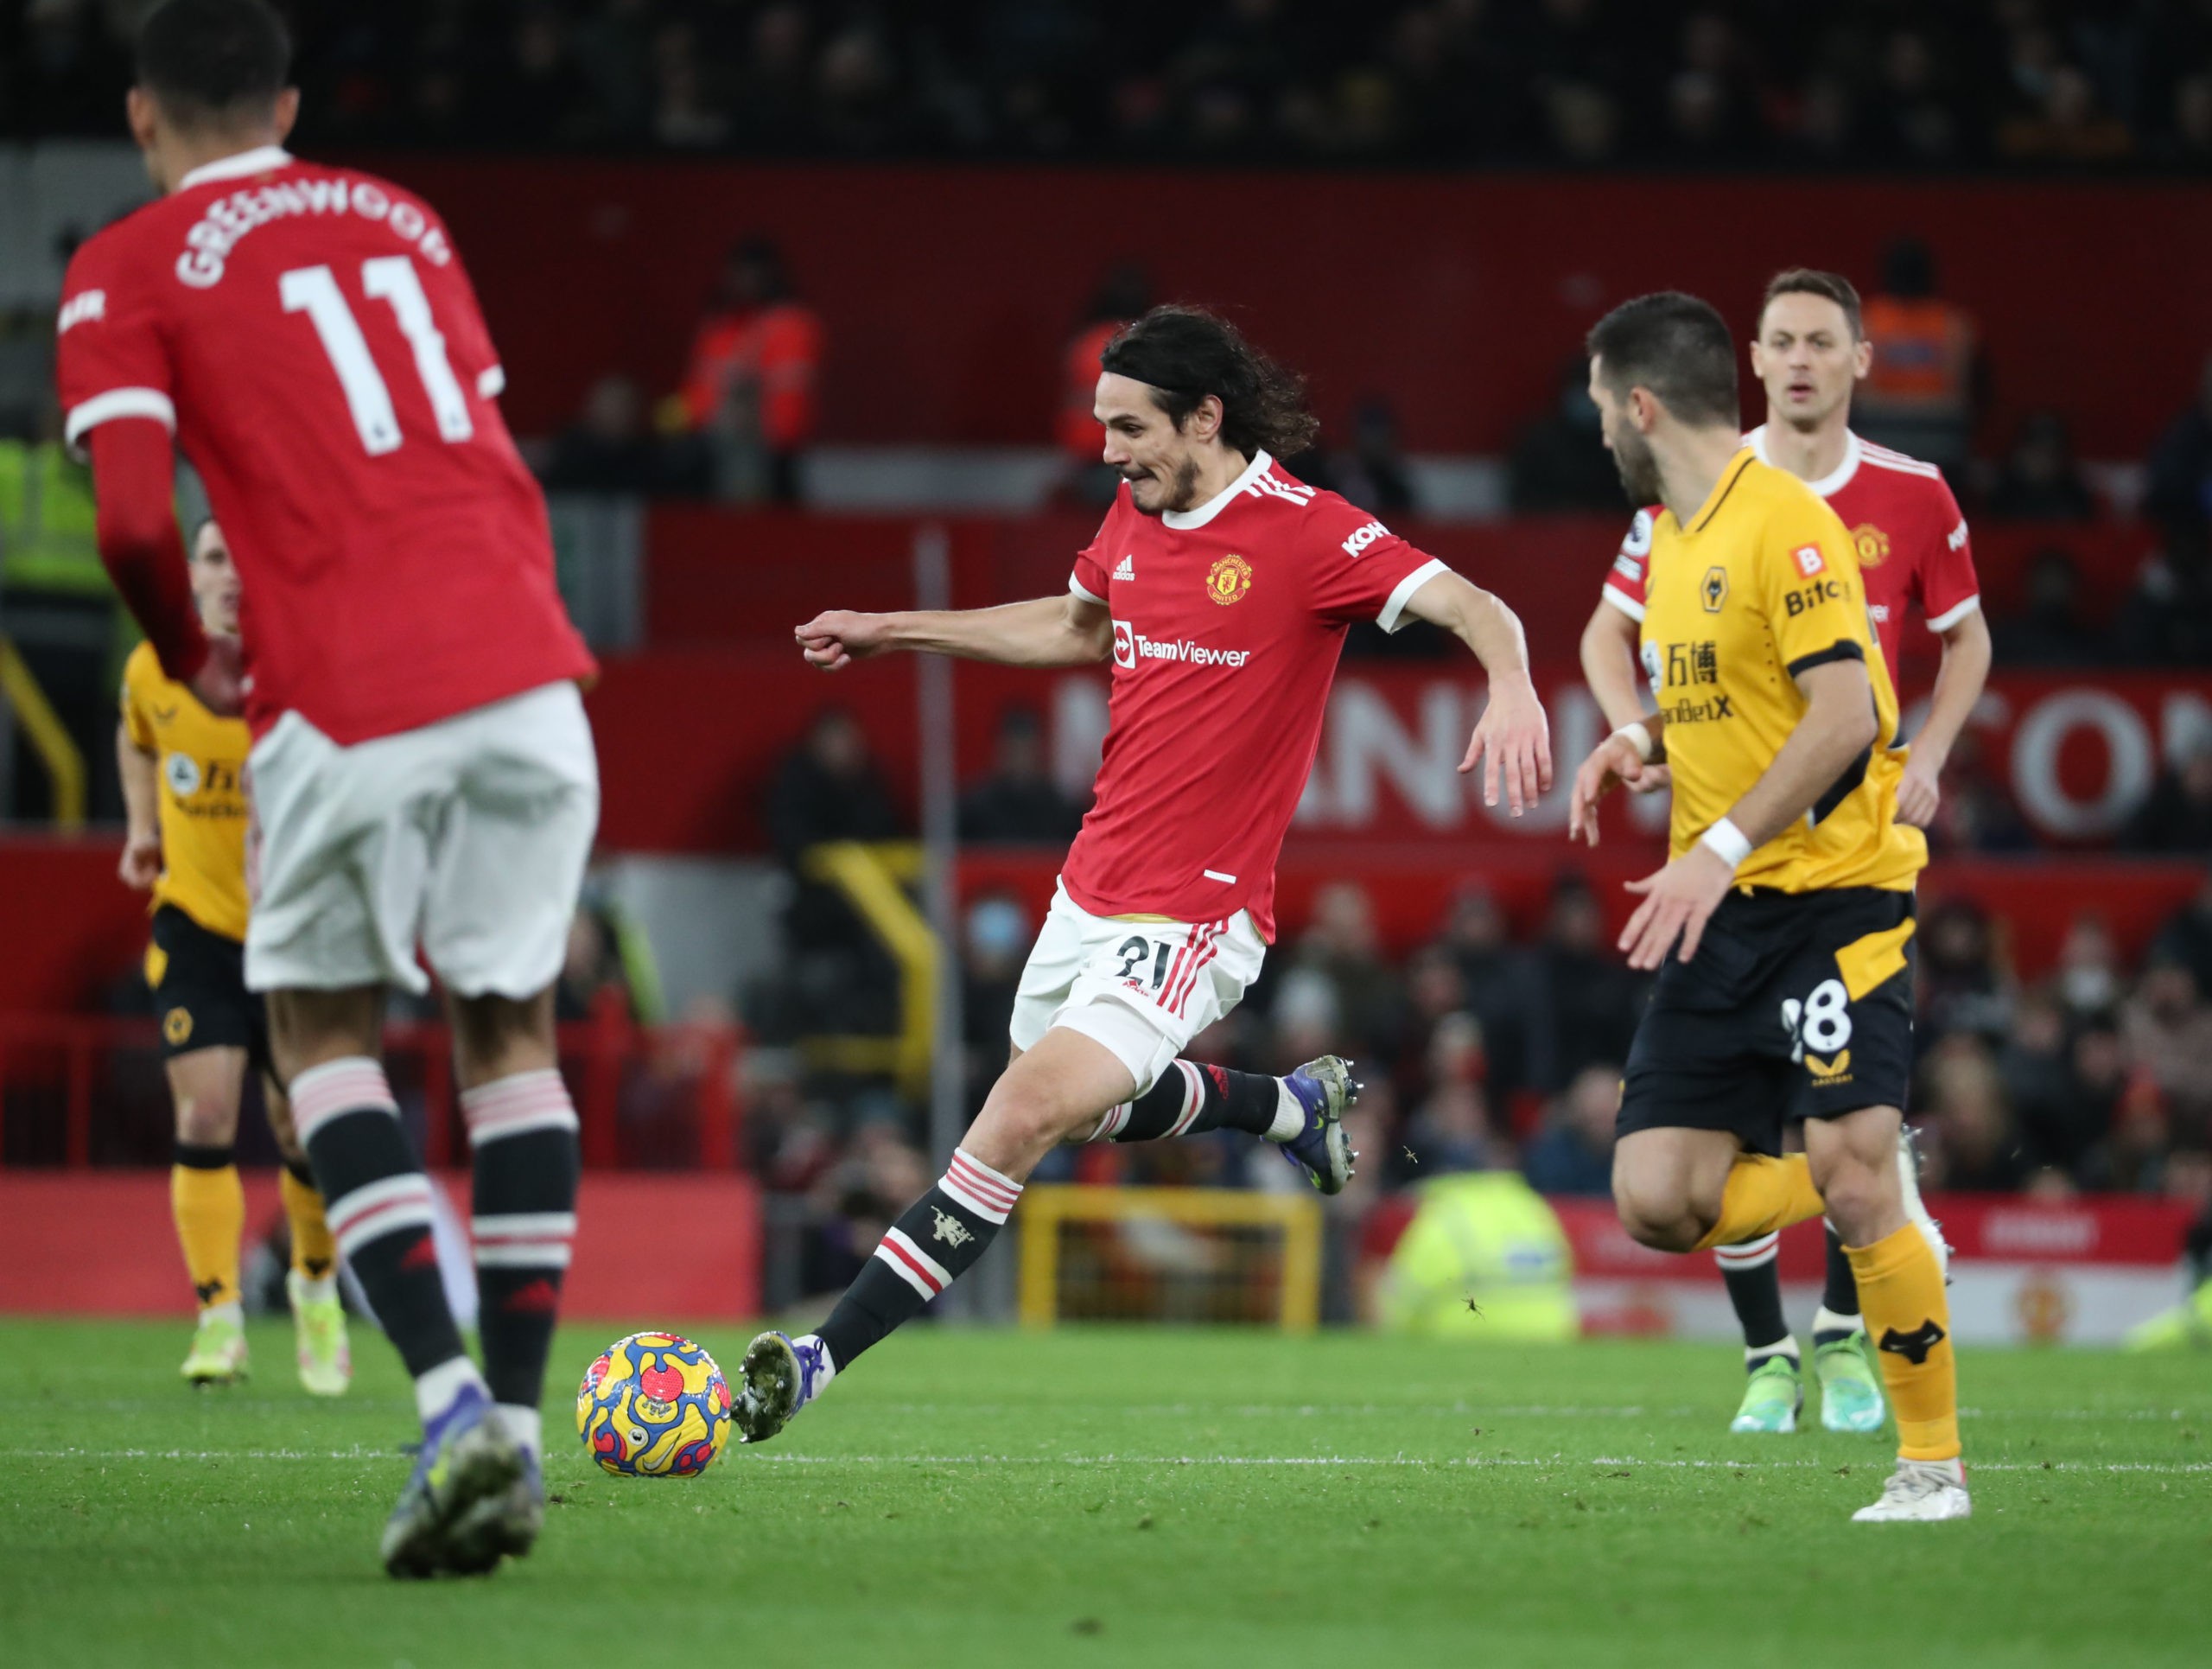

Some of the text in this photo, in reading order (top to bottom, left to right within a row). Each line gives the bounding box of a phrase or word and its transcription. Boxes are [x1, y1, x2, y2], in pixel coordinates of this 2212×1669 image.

[279, 256, 474, 456] 11
[1797, 547, 1822, 575] B
[1135, 635, 1250, 666] TeamViewer
[1667, 641, 1718, 686] 万博
[1114, 936, 1172, 990] 21
